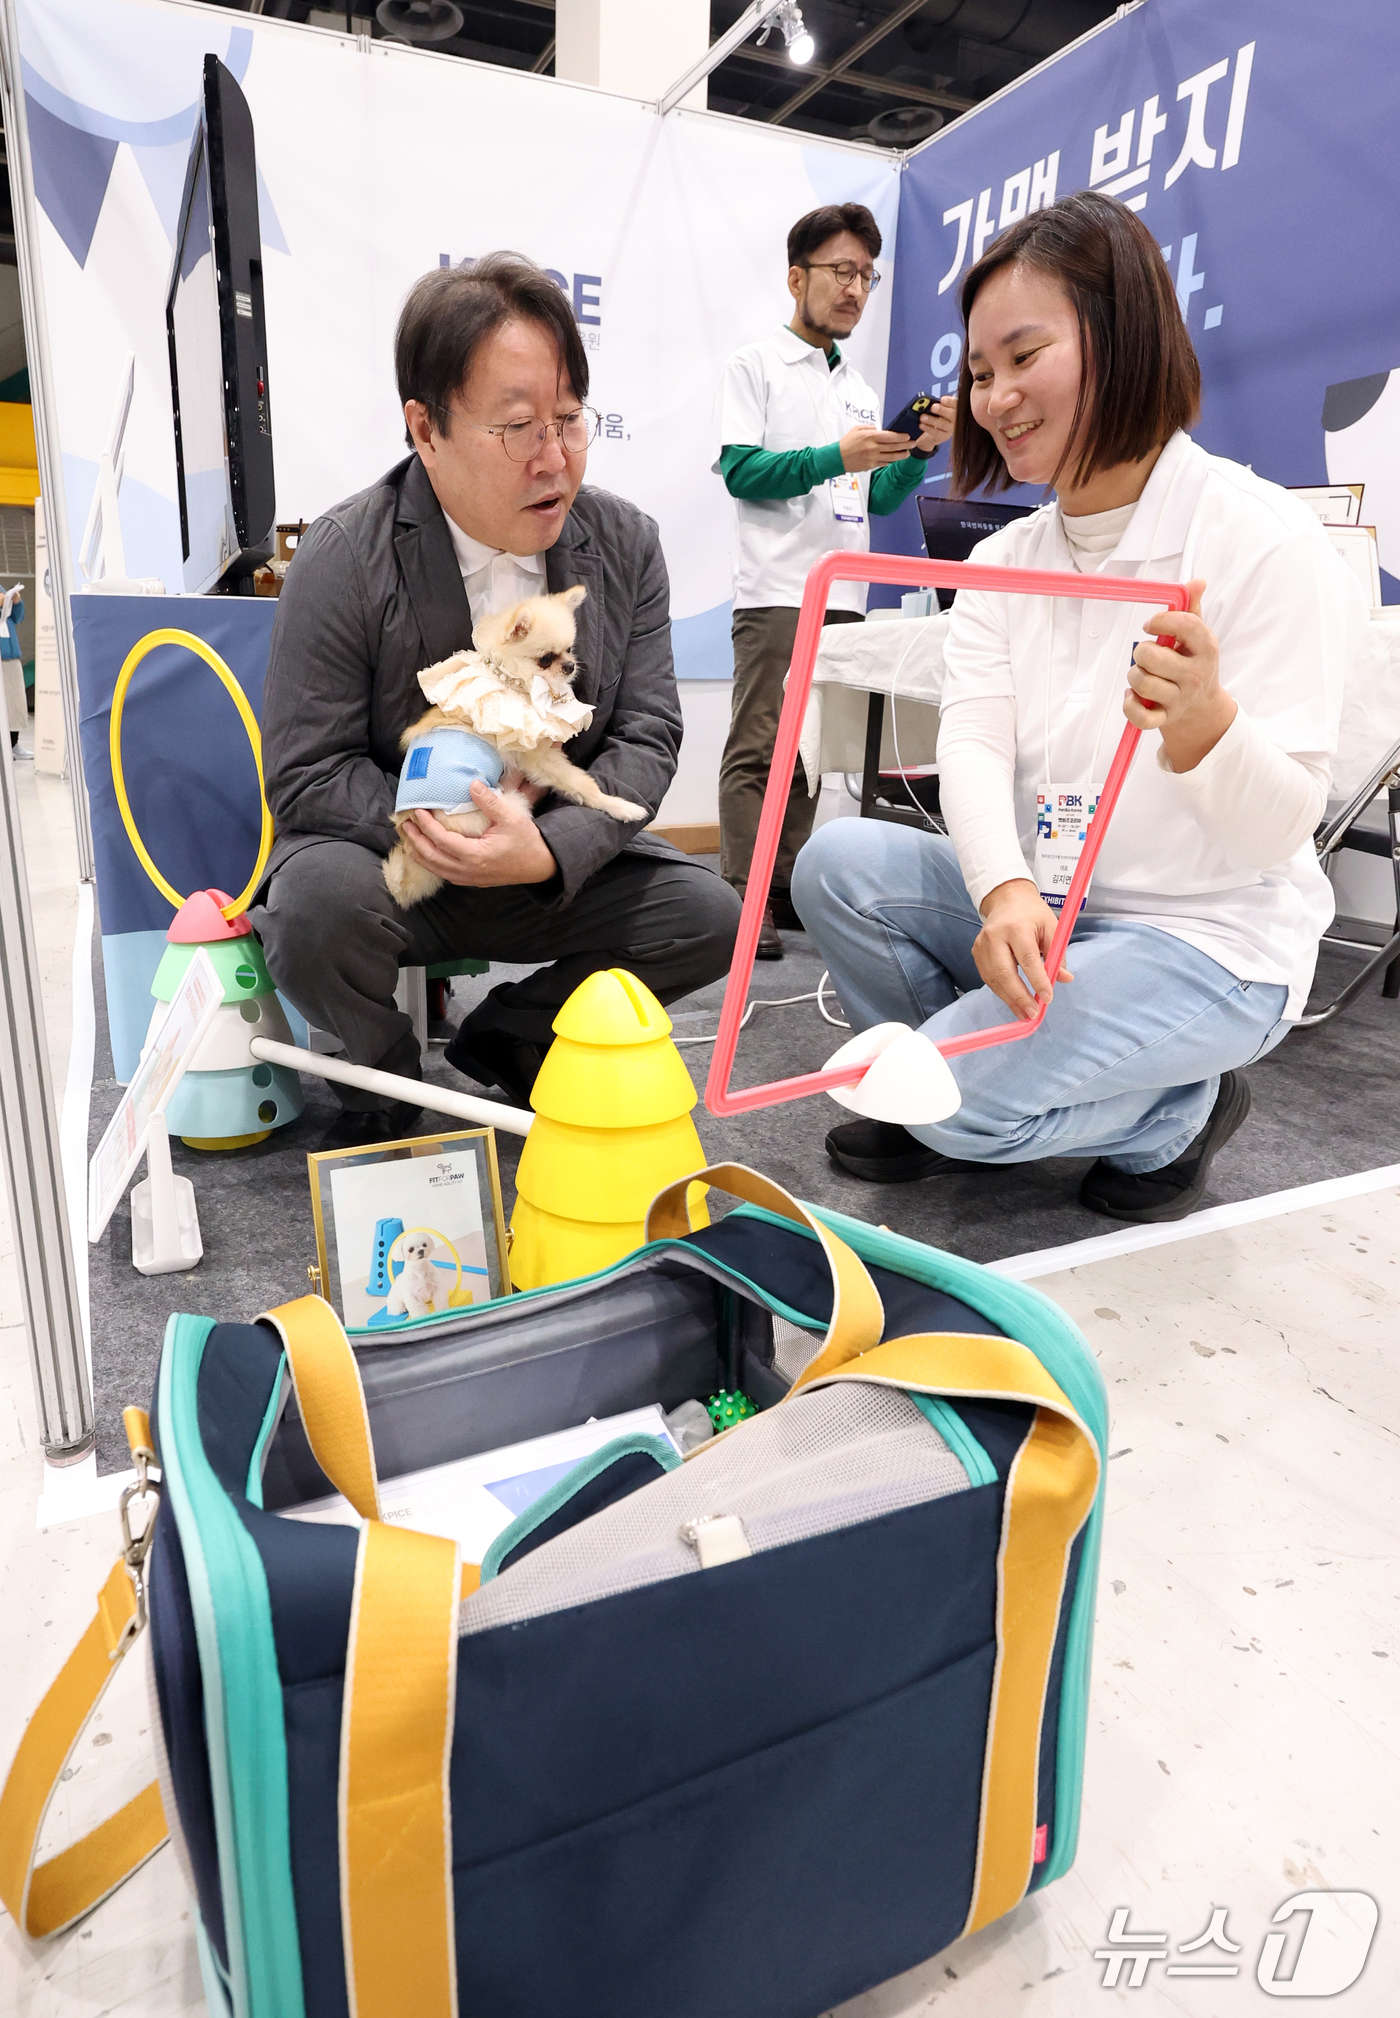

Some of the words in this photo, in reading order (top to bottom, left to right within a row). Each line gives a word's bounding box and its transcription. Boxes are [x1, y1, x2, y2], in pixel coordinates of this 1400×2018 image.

[1088, 40, 1257, 211] 받지
[844, 400, 877, 422] KPICE
[1058, 794, 1083, 807] PBK
[1053, 874, 1072, 885] 김지연
